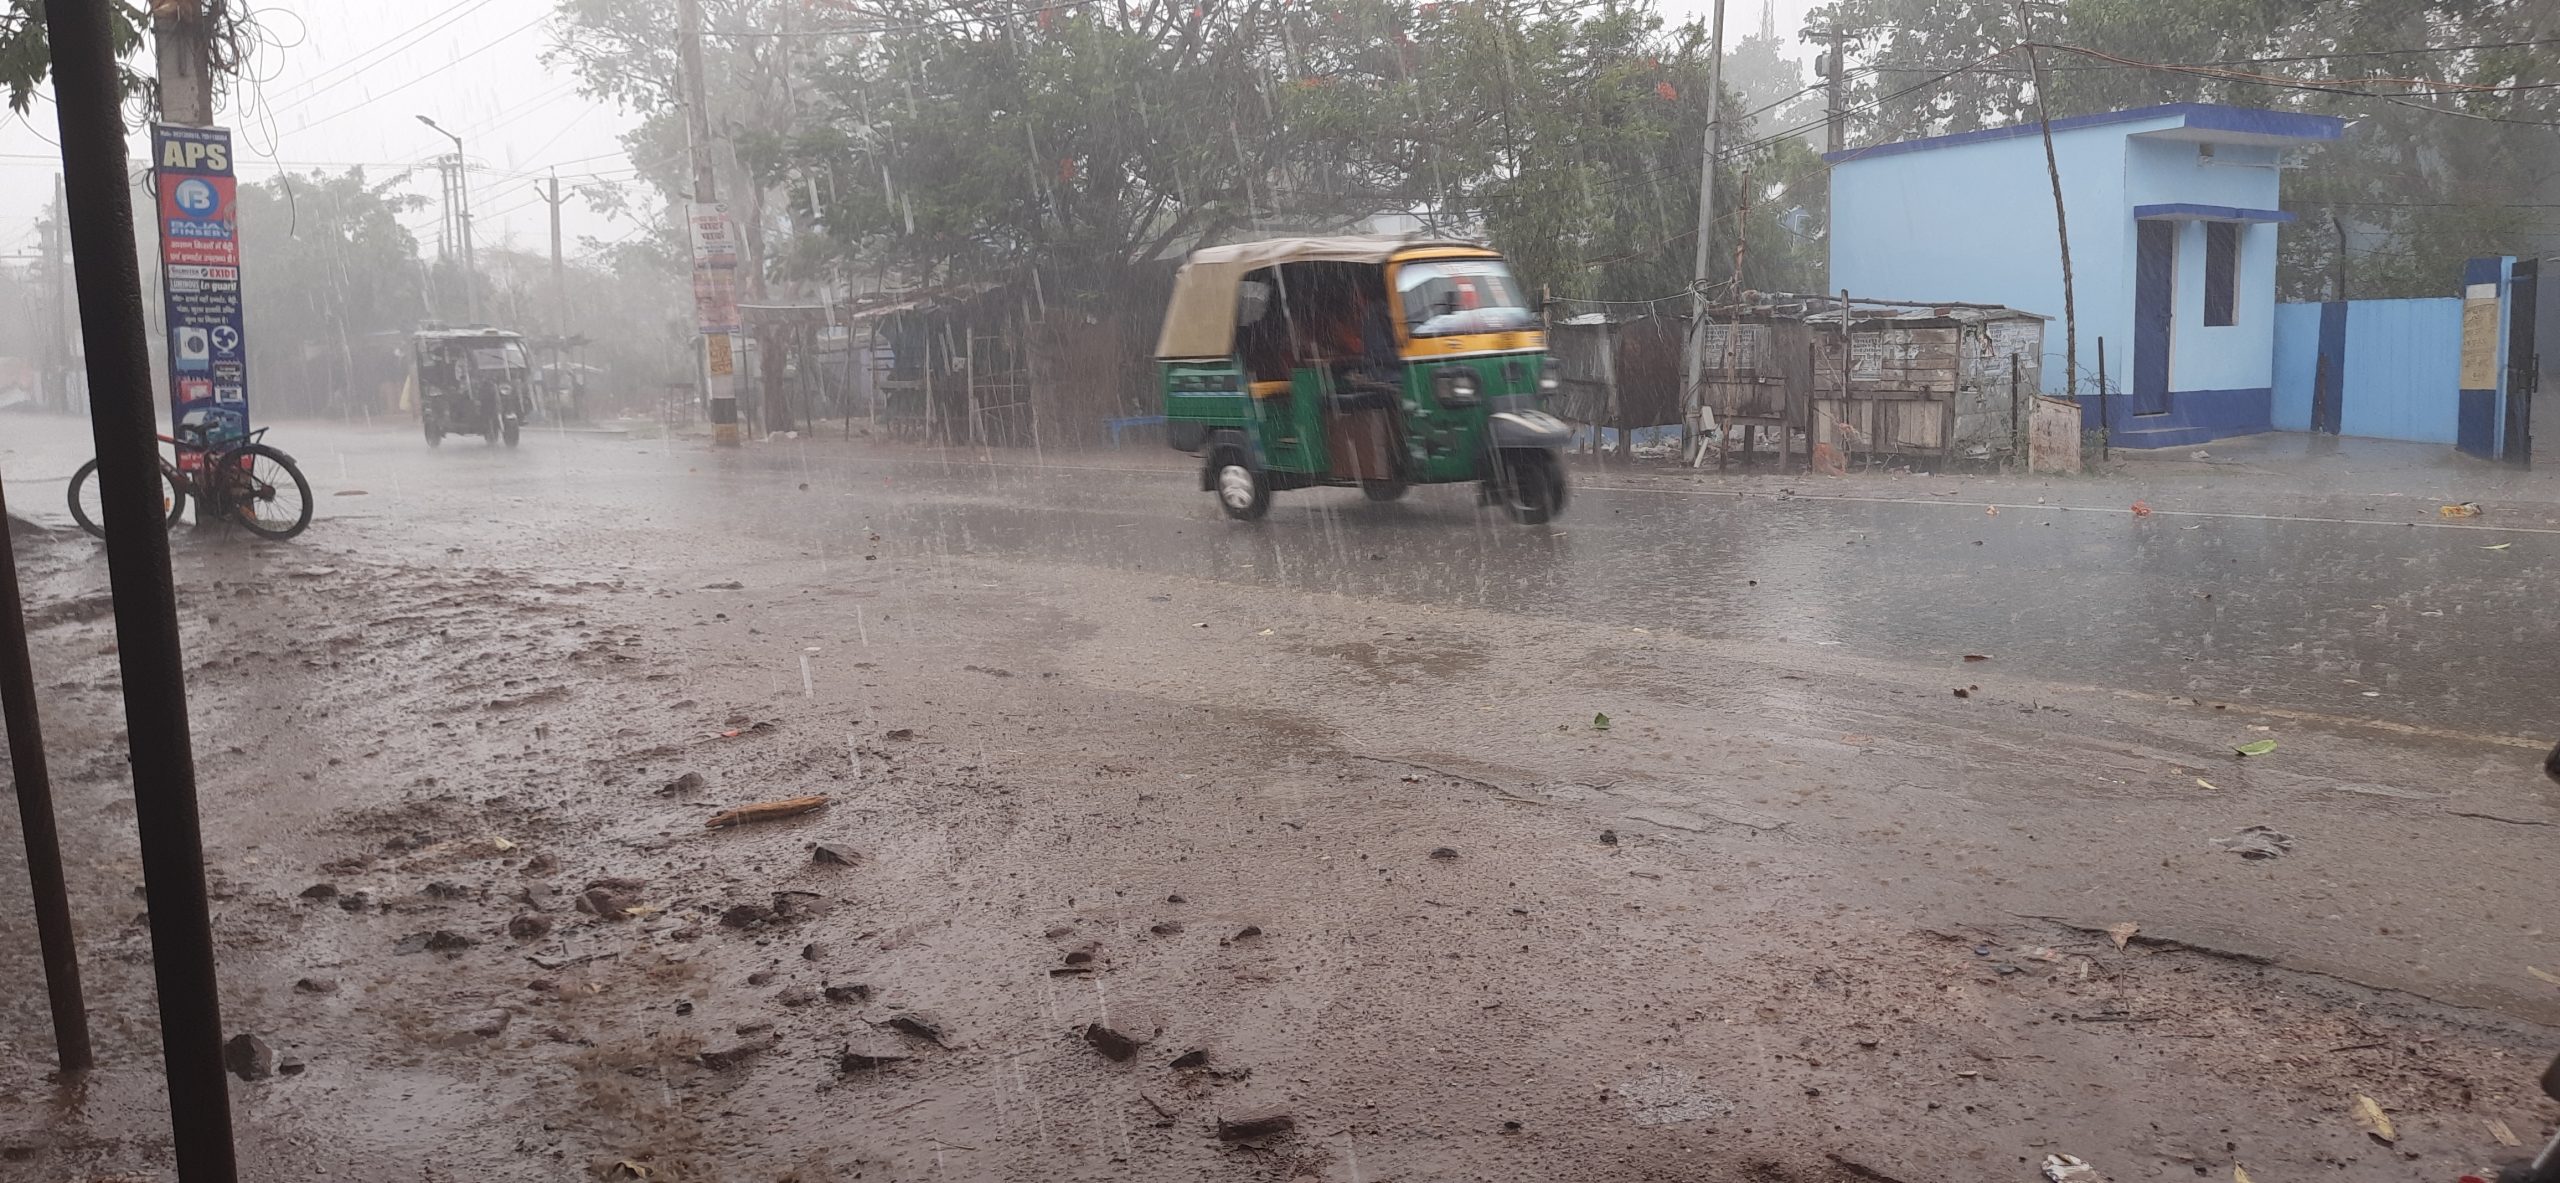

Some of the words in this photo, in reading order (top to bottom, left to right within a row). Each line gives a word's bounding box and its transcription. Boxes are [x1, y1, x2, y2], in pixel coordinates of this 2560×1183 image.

[163, 140, 228, 171] APS
[171, 229, 230, 237] FINSERV
[209, 268, 236, 278] EXIDE
